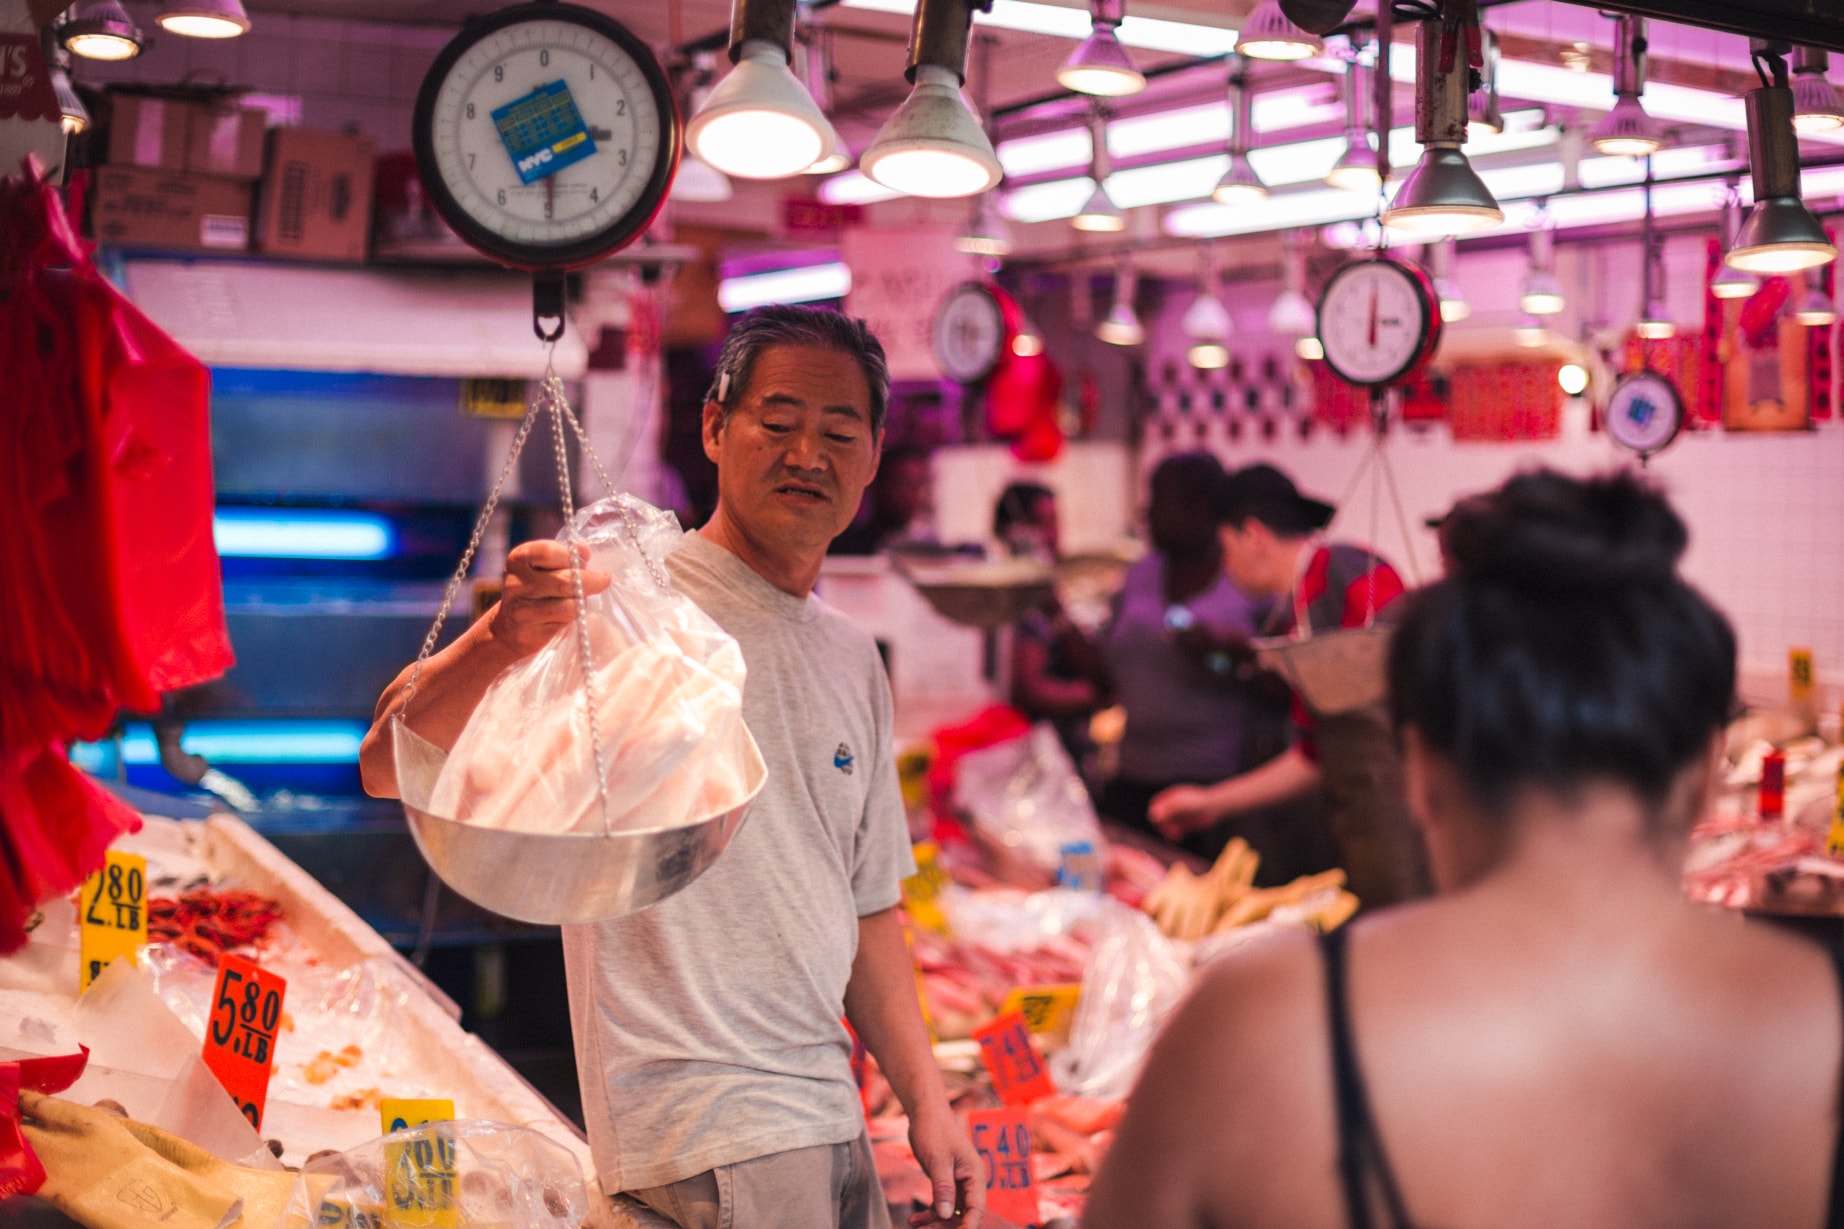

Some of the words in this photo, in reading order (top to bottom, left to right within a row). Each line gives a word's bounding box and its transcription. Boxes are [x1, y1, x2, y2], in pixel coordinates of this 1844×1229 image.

[539, 50, 549, 67] 0
[494, 66, 504, 83] 9
[466, 103, 476, 120] 8
[616, 99, 626, 117] 2
[468, 153, 476, 171] 7
[618, 149, 627, 167] 3
[497, 189, 507, 206] 6
[590, 187, 600, 204] 4
[544, 203, 553, 220] 5
